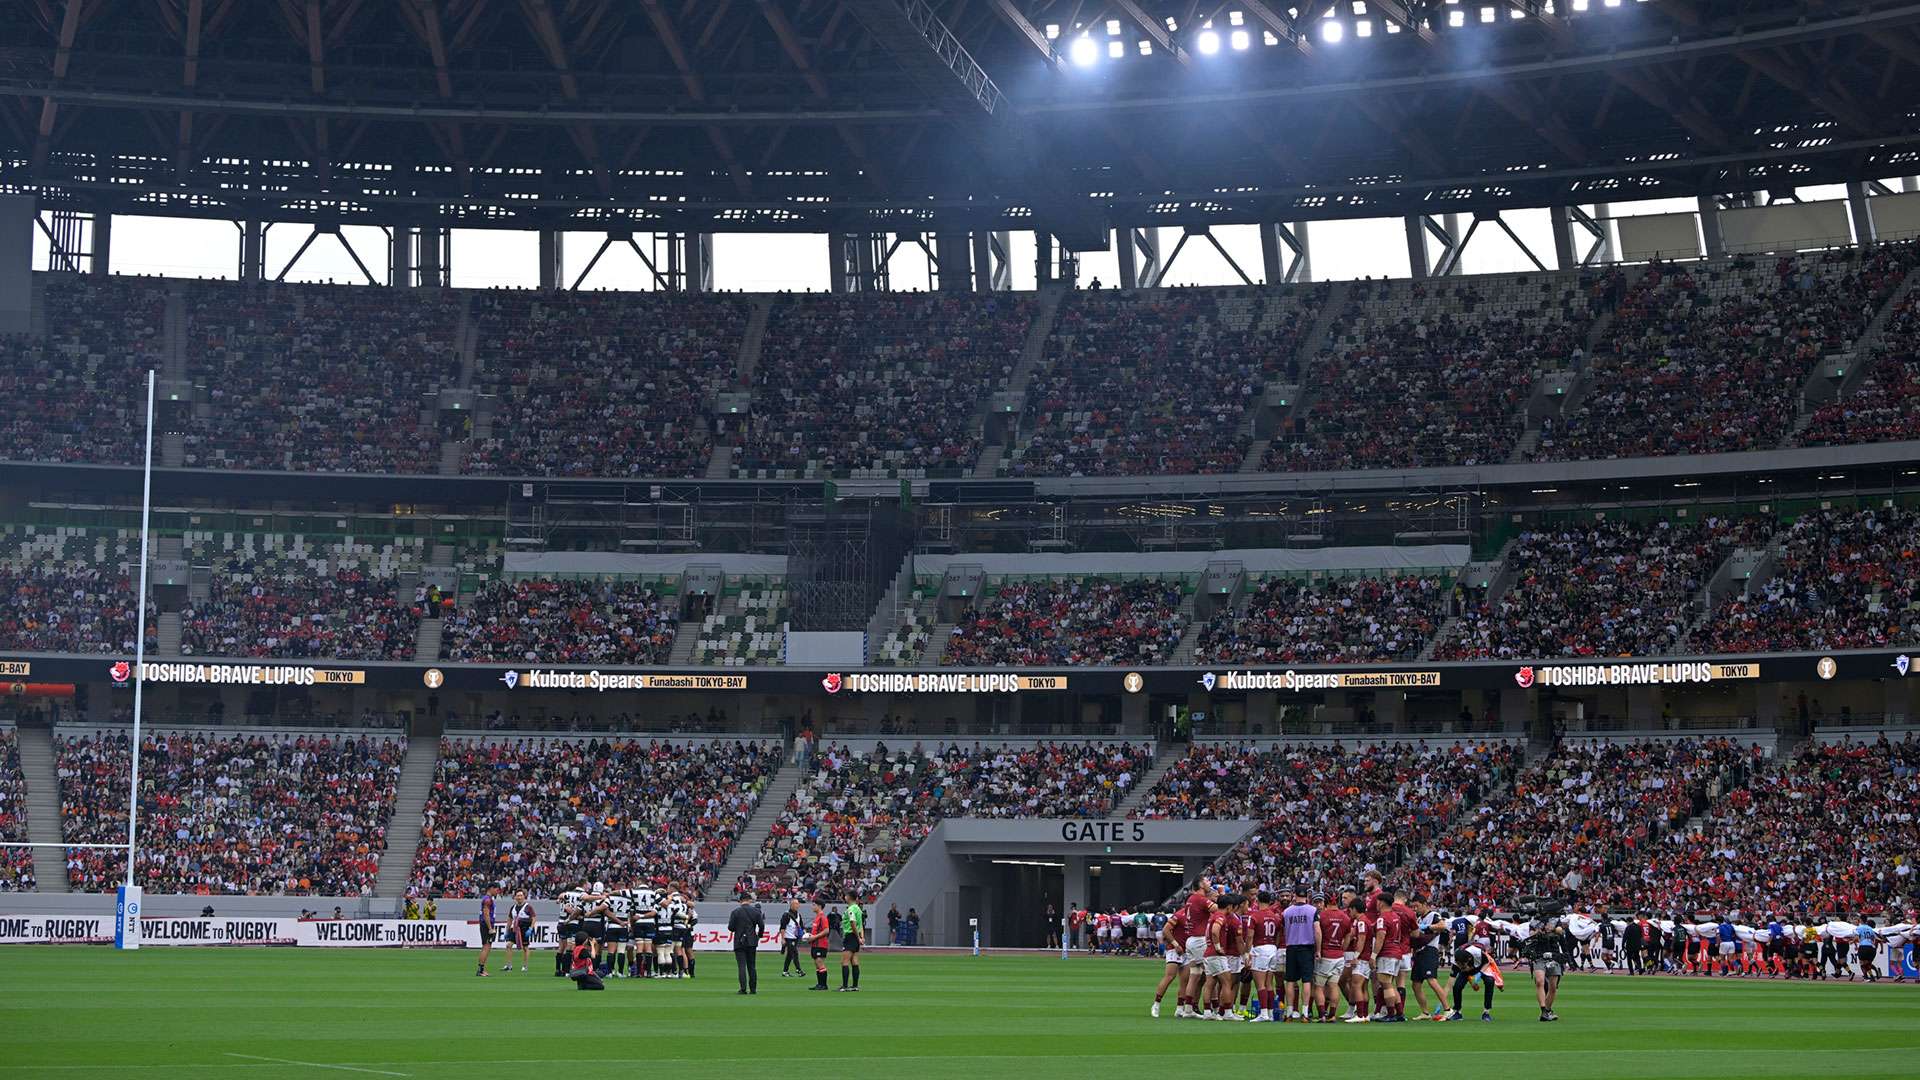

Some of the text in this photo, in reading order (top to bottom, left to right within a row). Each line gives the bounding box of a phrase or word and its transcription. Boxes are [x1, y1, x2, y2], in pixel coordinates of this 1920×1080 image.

[141, 663, 353, 685] TOSHIBA BRAVE LUPUS TOKYO
[530, 670, 743, 691] Kubota Spears Funabashi TOKYO-BAY
[850, 673, 1056, 693] TOSHIBA BRAVE LUPUS TOKYO
[1227, 670, 1437, 692] Kubota Spears Funabashi TOKYO-BAY
[1543, 662, 1748, 686] TOSHIBA BRAVE LUPUS TOKYO
[1062, 821, 1145, 841] GATE 5
[617, 900, 623, 912] 2
[641, 894, 647, 905] 4
[45, 919, 100, 938] RUGBY!
[140, 920, 211, 939] WELCOME
[225, 921, 277, 940] RUGBY!
[316, 922, 383, 941] WELCOME
[397, 924, 447, 941] RUGBY!
[1264, 920, 1275, 936] 10
[1331, 922, 1340, 938] 7
